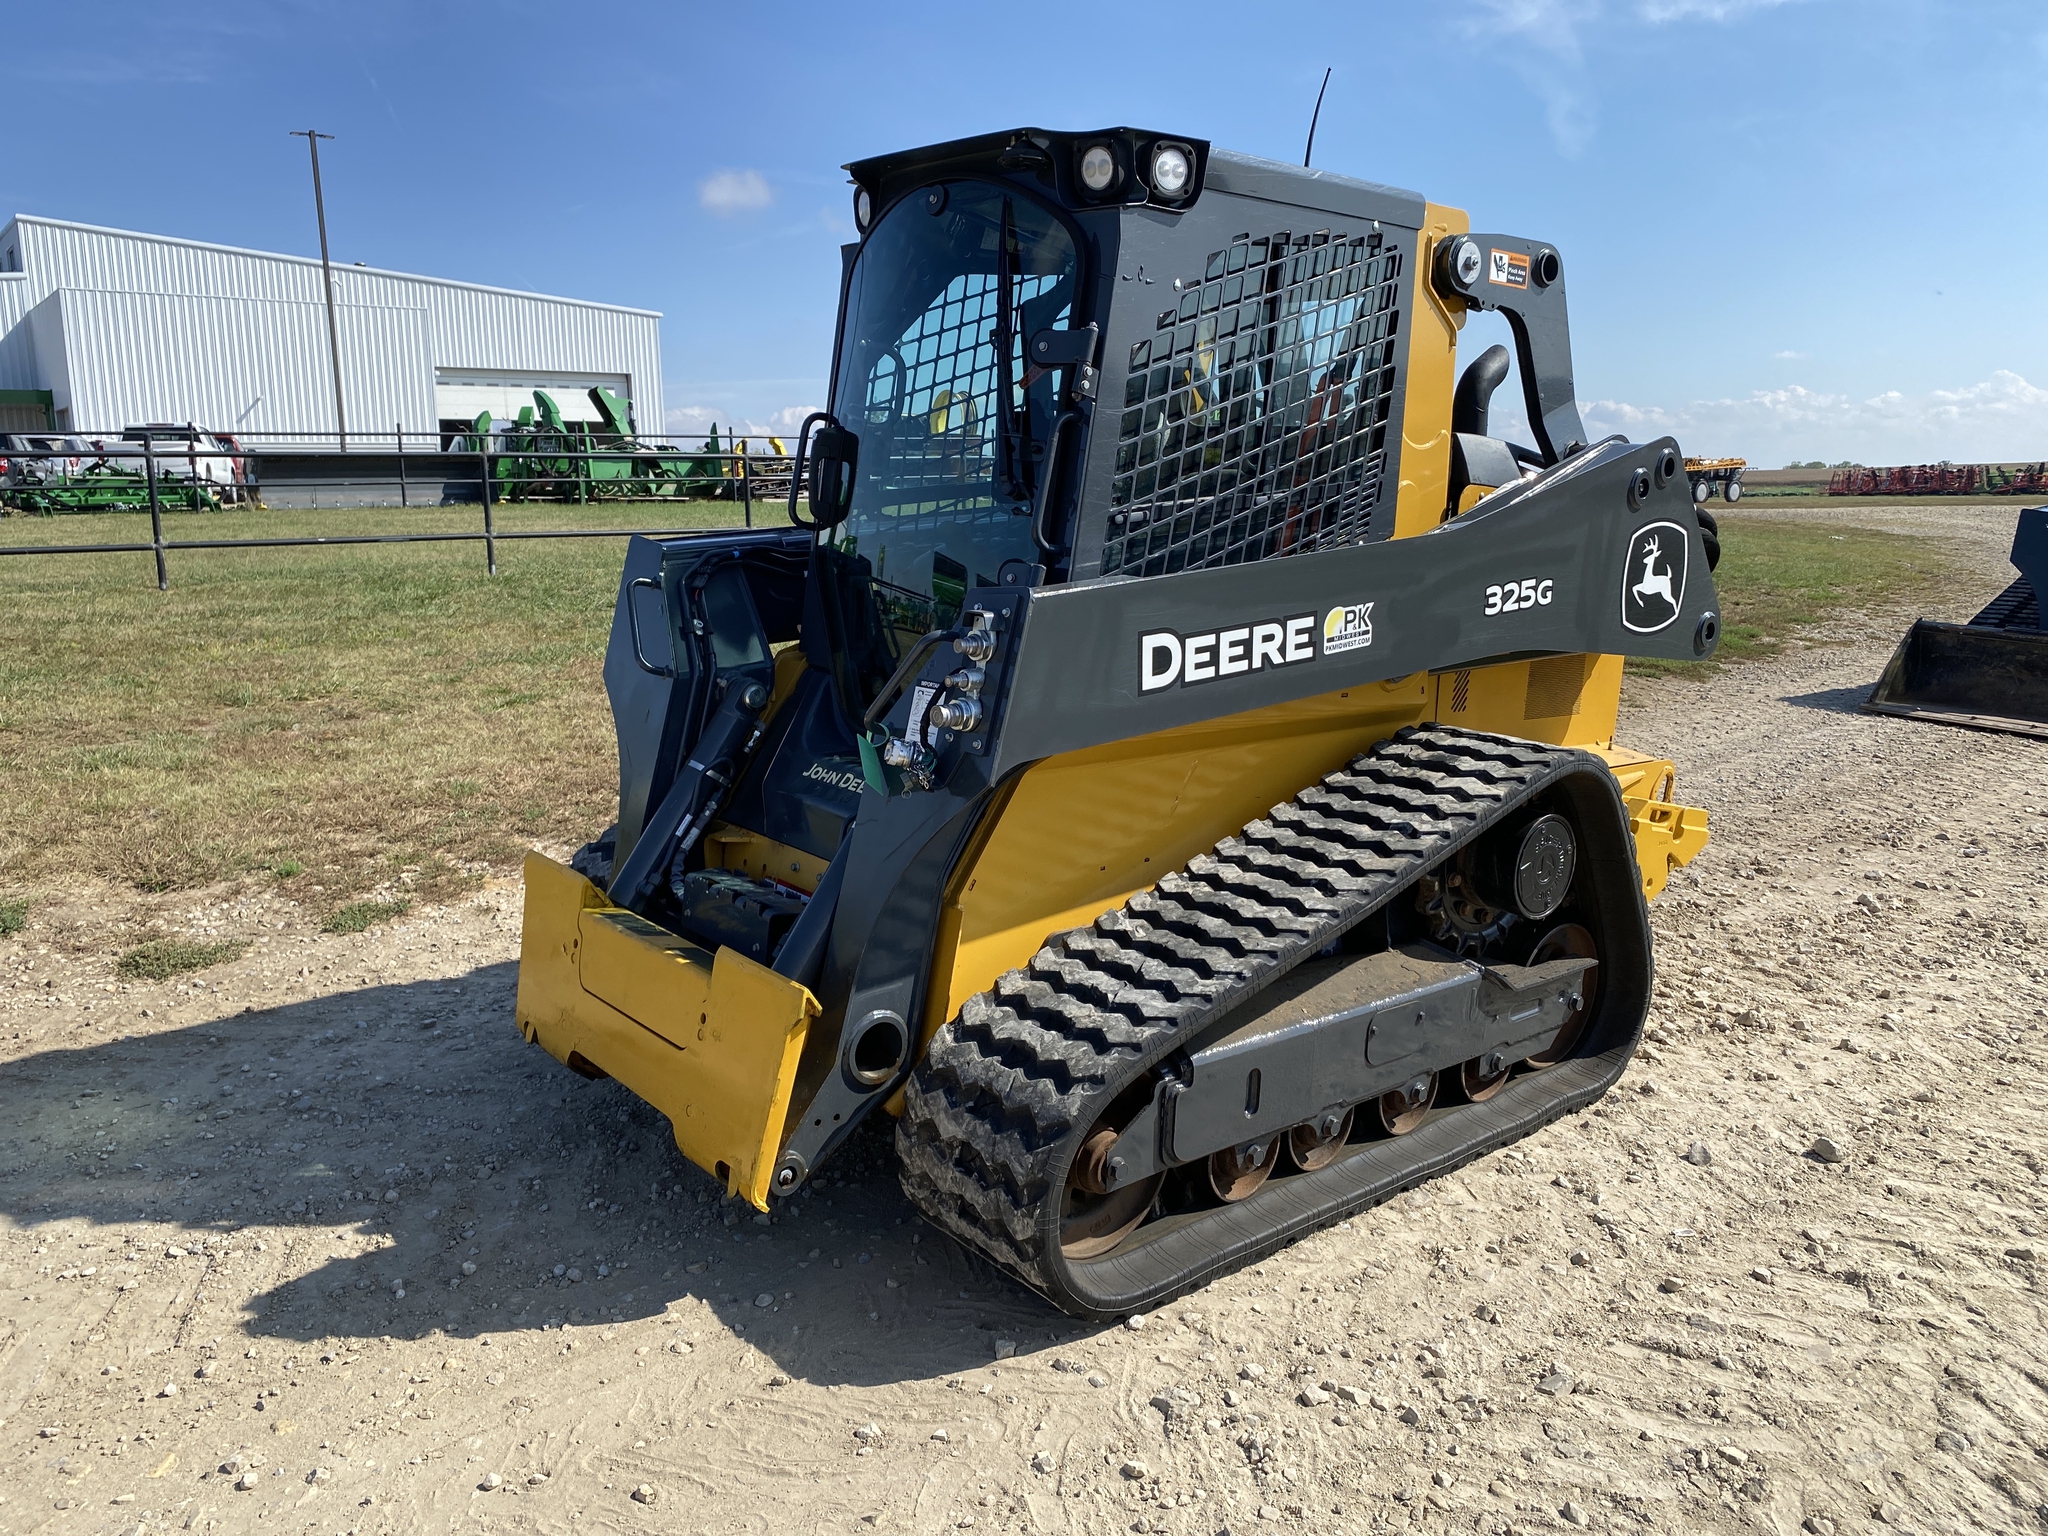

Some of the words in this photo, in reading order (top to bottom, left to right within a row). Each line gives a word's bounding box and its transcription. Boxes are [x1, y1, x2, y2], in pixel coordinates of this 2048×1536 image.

[1484, 578, 1553, 616] 325G
[1142, 616, 1315, 691] DEERE
[1325, 636, 1371, 652] PKMIDWEST.COM
[920, 680, 940, 689] IMPORTA
[802, 763, 842, 785] JOHN
[838, 773, 865, 794] DEE
